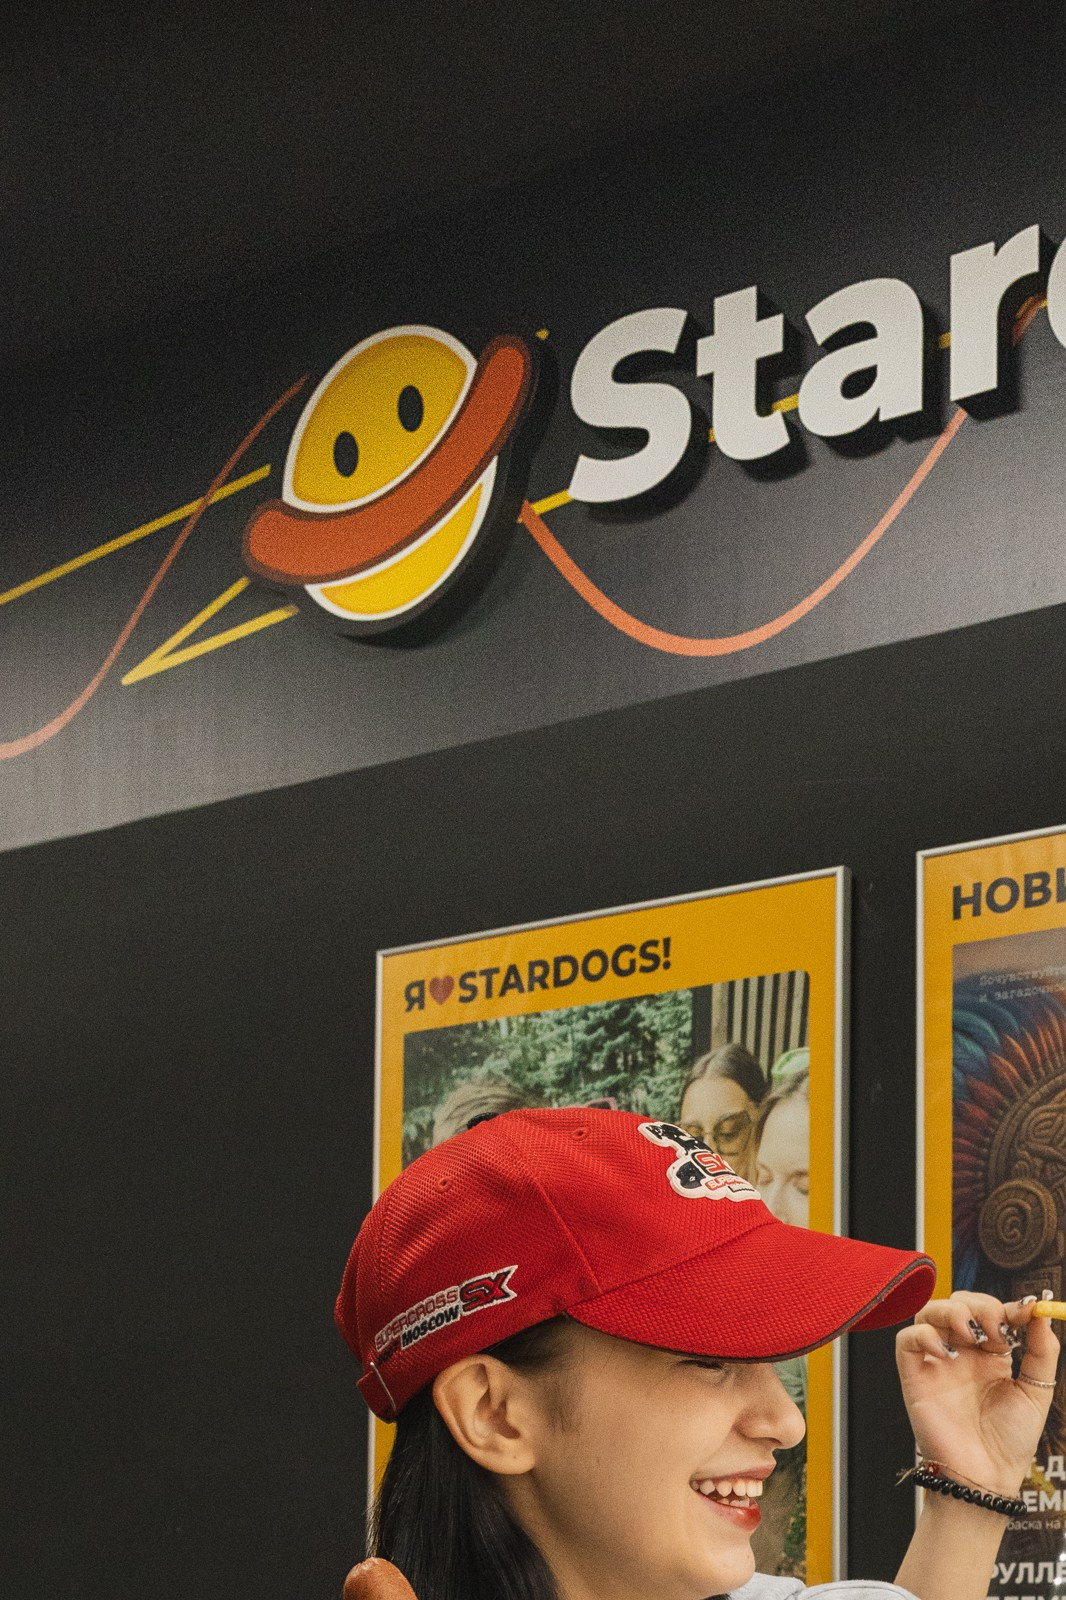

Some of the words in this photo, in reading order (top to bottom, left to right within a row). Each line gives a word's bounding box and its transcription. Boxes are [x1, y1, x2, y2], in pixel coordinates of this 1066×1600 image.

[403, 979, 426, 1012] Я
[458, 937, 672, 1004] STARDOGS!
[459, 1270, 512, 1313] SX
[375, 1288, 459, 1350] SUPERCROSS
[401, 1304, 460, 1348] MOSCOW
[1007, 1516, 1043, 1532] баска
[1045, 1519, 1061, 1531] на
